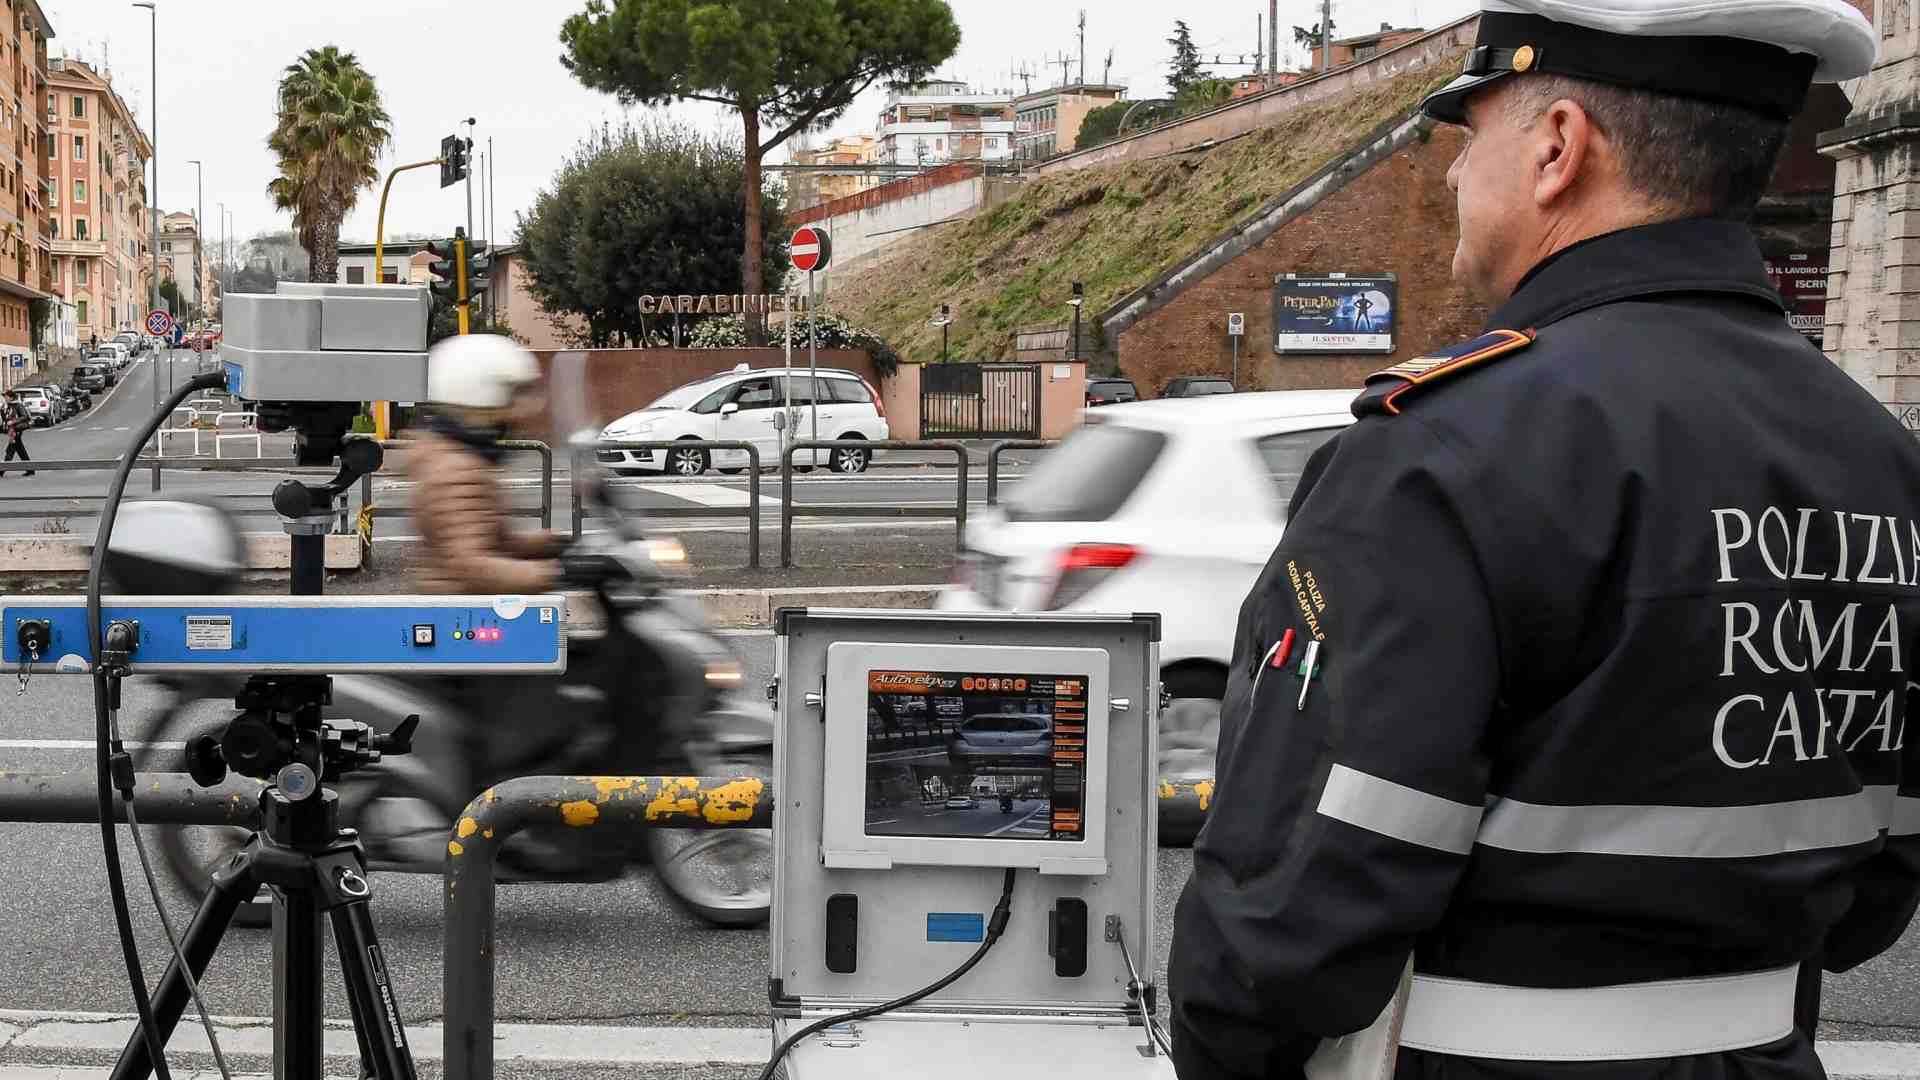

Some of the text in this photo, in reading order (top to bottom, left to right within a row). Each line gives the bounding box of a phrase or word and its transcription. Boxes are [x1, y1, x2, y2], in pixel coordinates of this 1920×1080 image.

[638, 294, 809, 314] CARABINIERI
[1284, 295, 1344, 310] PETER PAN
[1287, 560, 1325, 641] ROMA CAPITALE
[1304, 570, 1326, 613] POLIZIA
[1719, 599, 1904, 676] ROMA
